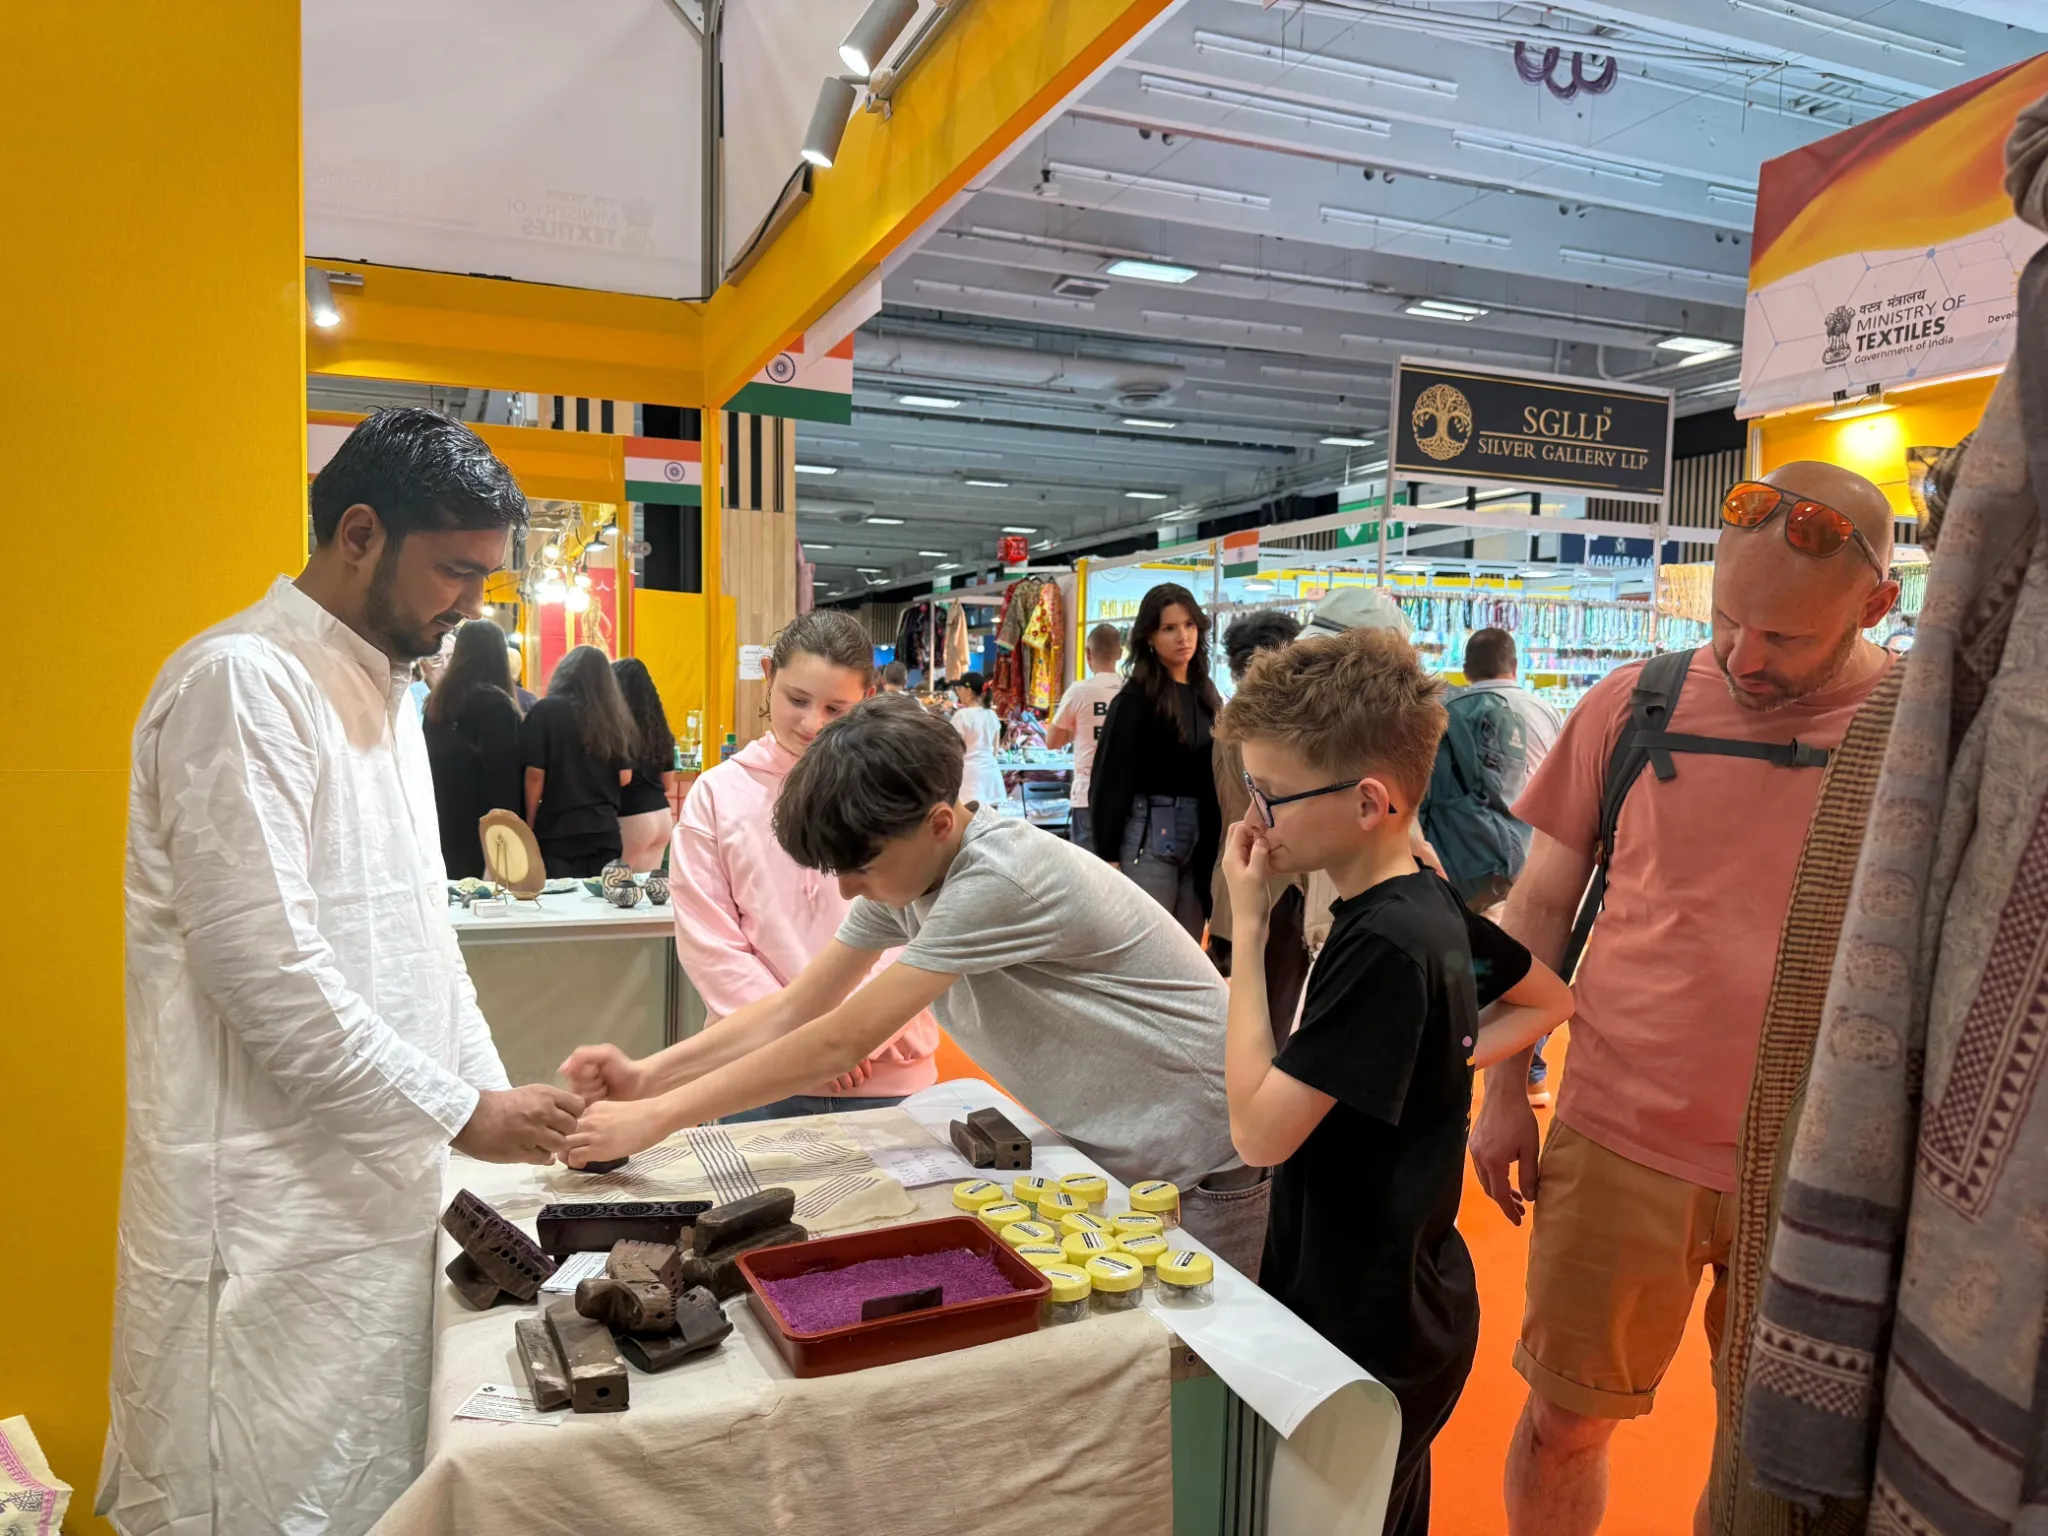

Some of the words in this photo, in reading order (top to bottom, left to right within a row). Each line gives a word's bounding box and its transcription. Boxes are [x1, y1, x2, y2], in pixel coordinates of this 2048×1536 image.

[1856, 301, 1938, 333] MINISTRY
[1942, 294, 1966, 312] OF
[1859, 300, 1883, 315] वस्त्र
[1887, 289, 1928, 309] मंत्रालय
[1854, 343, 1914, 364] Government
[1915, 341, 1926, 351] of
[1928, 335, 1954, 348] India
[1856, 316, 1946, 353] TEXTILES
[1522, 405, 1612, 442] SGLLP
[1477, 437, 1536, 460] SILVER
[1542, 445, 1617, 468] GALLERY
[1620, 453, 1649, 471] LLP
[1587, 554, 1653, 569] MAHARAJA
